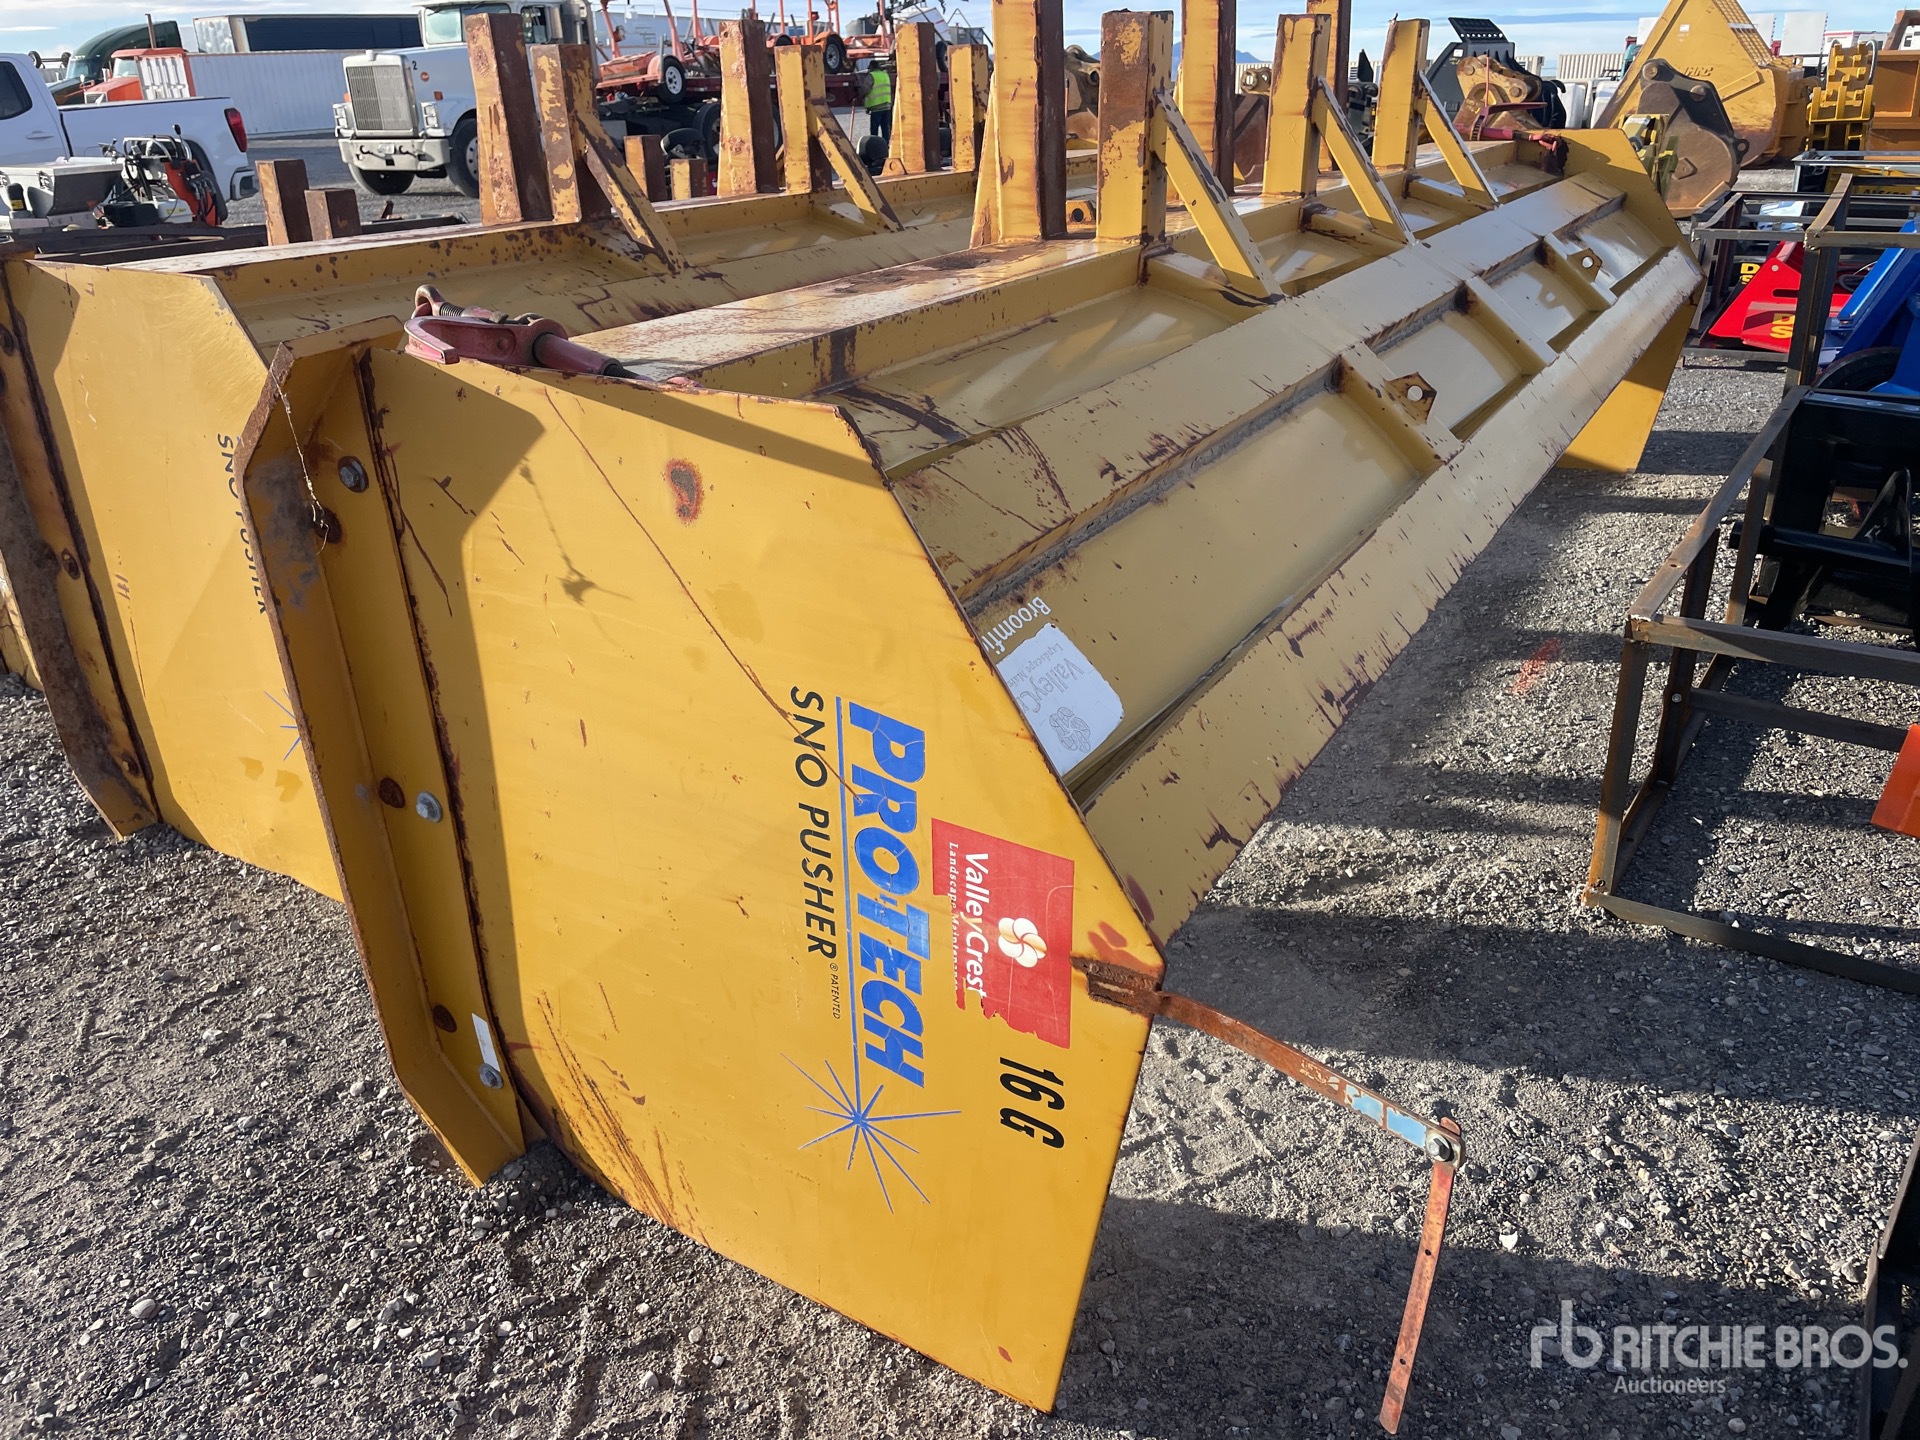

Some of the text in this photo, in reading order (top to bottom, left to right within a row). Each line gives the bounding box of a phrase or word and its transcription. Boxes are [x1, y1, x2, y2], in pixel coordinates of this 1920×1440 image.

[790, 686, 837, 960] SNO PUSHER
[948, 842, 959, 909] Landscape
[960, 853, 990, 998] ValleyCrest
[830, 974, 841, 1019] PATENTED
[1000, 1057, 1065, 1110] 16
